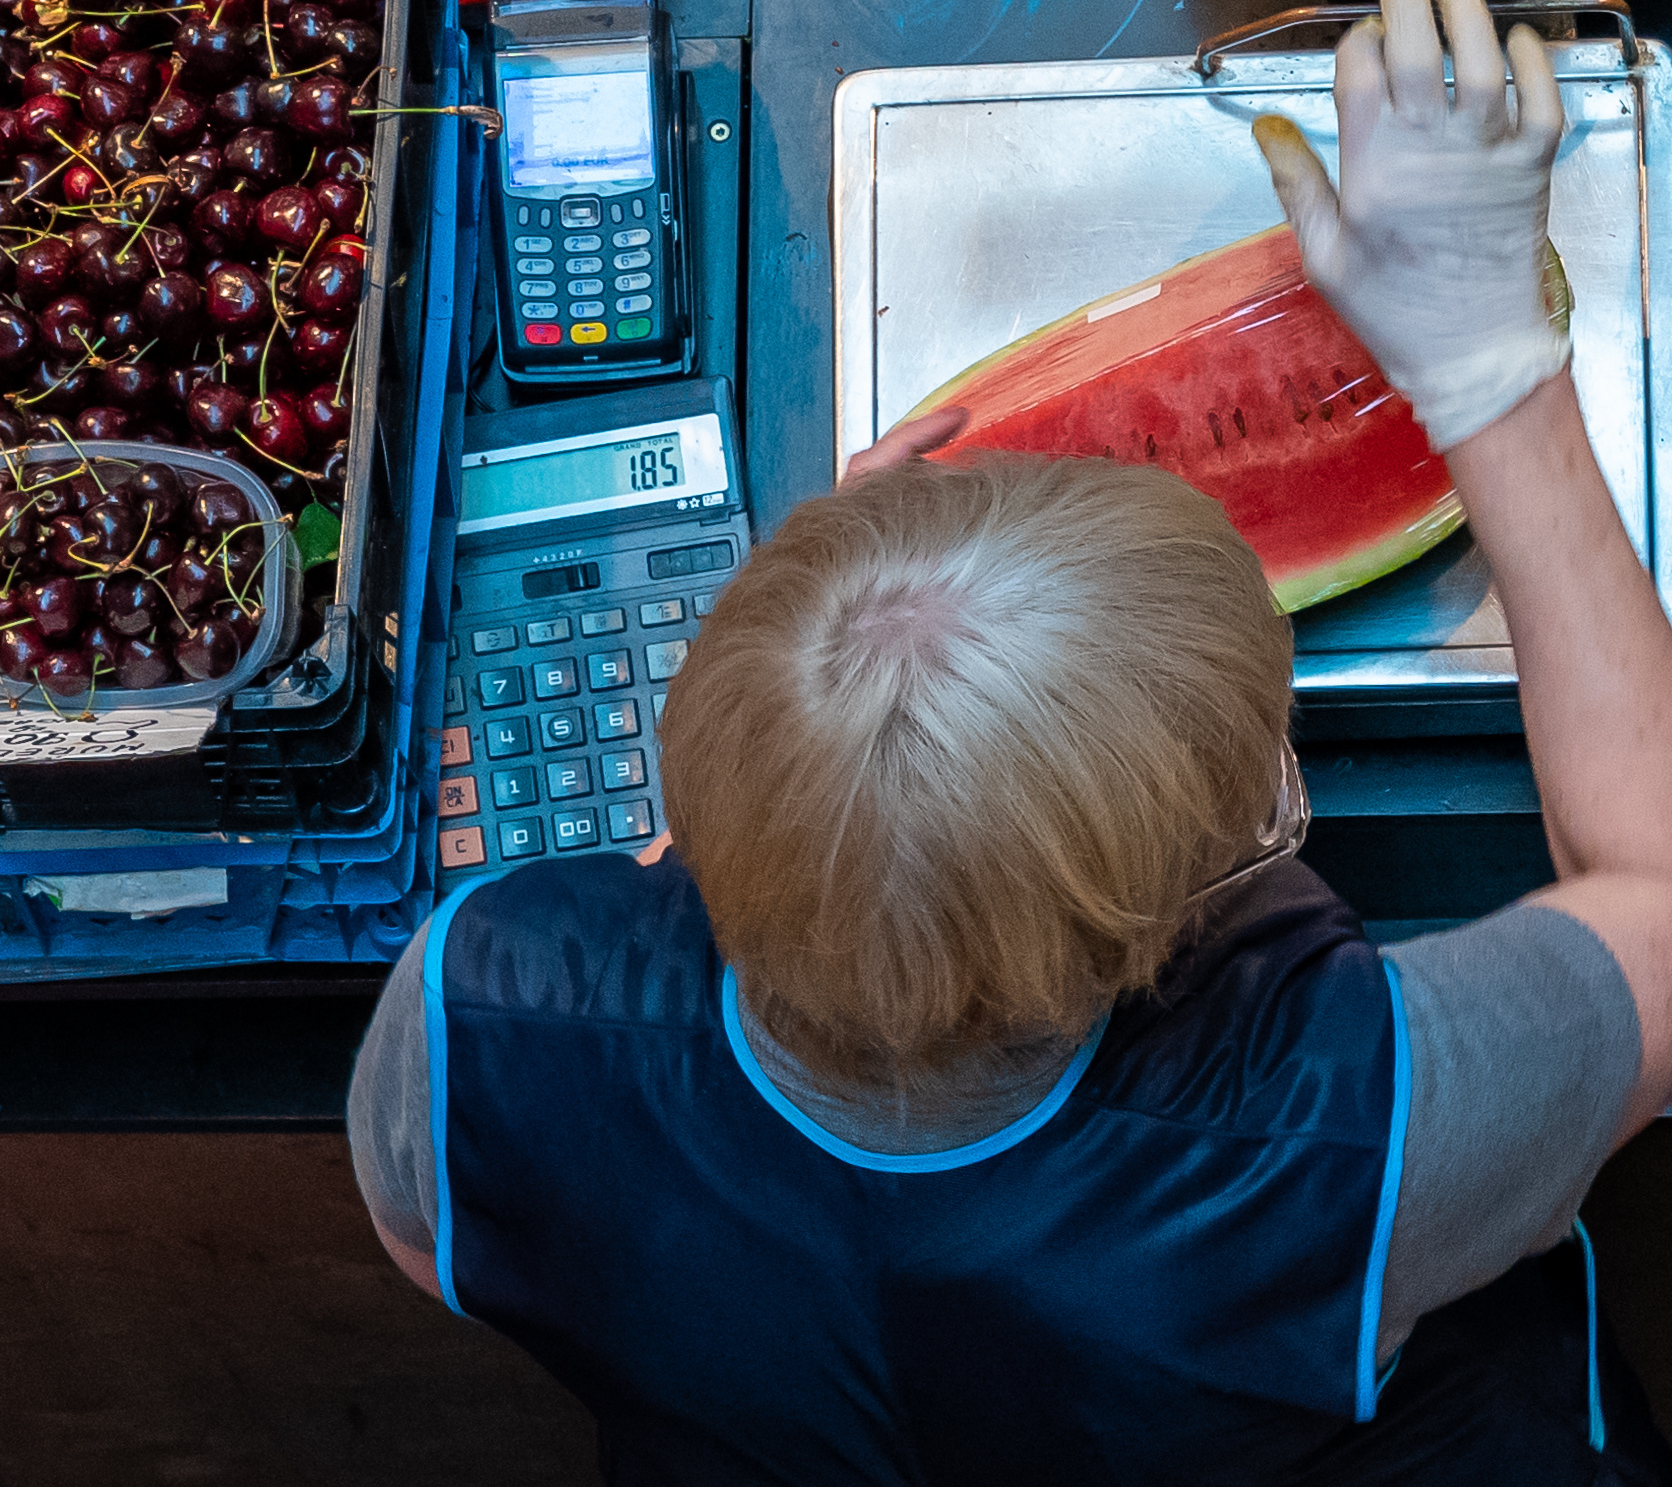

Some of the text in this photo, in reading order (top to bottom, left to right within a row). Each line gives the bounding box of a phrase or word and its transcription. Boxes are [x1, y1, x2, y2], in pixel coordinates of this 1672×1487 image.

[571, 238, 579, 249] 2
[620, 232, 629, 244] 3
[525, 261, 533, 271] 4
[573, 260, 582, 272] 5
[620, 255, 629, 267] 6
[527, 282, 534, 293] 7
[574, 282, 583, 293] 8
[621, 277, 630, 289] 9
[647, 437, 674, 447] TOTAL
[493, 662, 617, 694] 7 8 9
[500, 729, 515, 744] 4
[554, 720, 569, 736] 5
[609, 712, 624, 727] 6
[509, 780, 520, 794] 1
[561, 770, 576, 786] 2
[616, 762, 630, 777] 3
[455, 819, 591, 854] C 0 00
